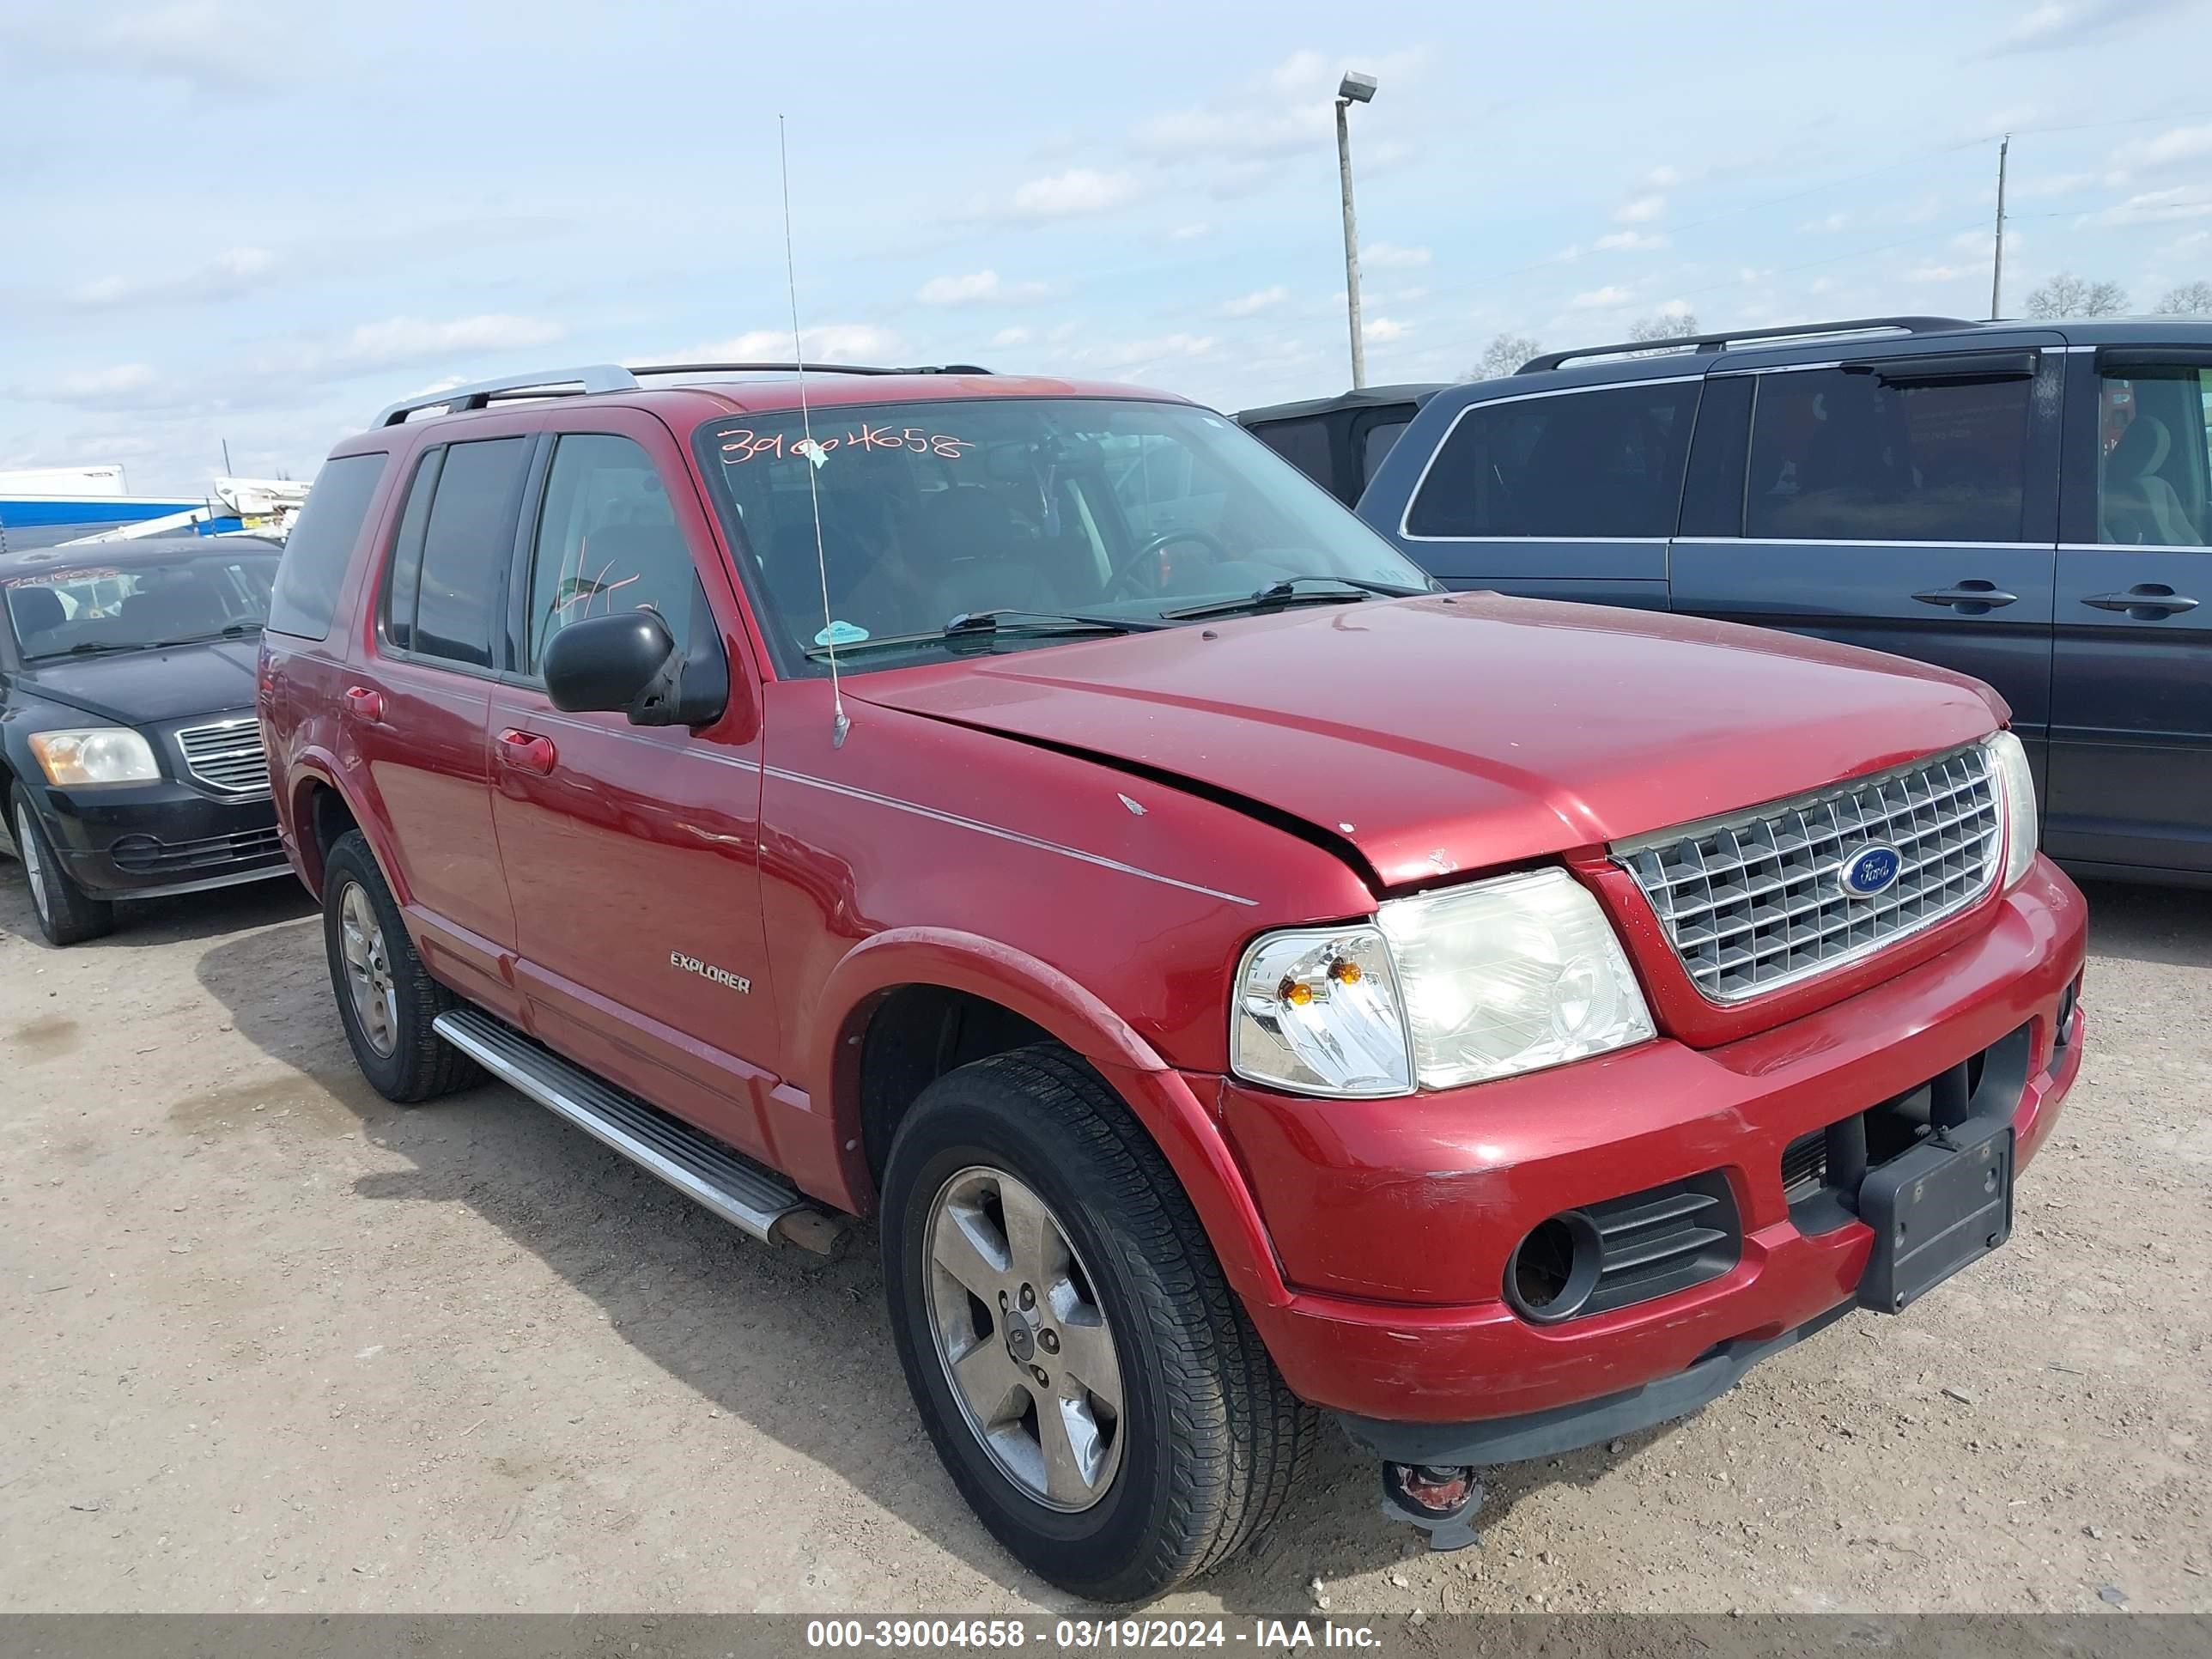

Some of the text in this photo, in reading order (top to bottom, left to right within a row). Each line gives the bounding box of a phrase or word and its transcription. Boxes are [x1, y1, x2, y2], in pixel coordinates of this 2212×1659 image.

[717, 423, 976, 465] 39004658
[1860, 859, 1890, 884] Ford
[670, 951, 751, 994] EXPLORER
